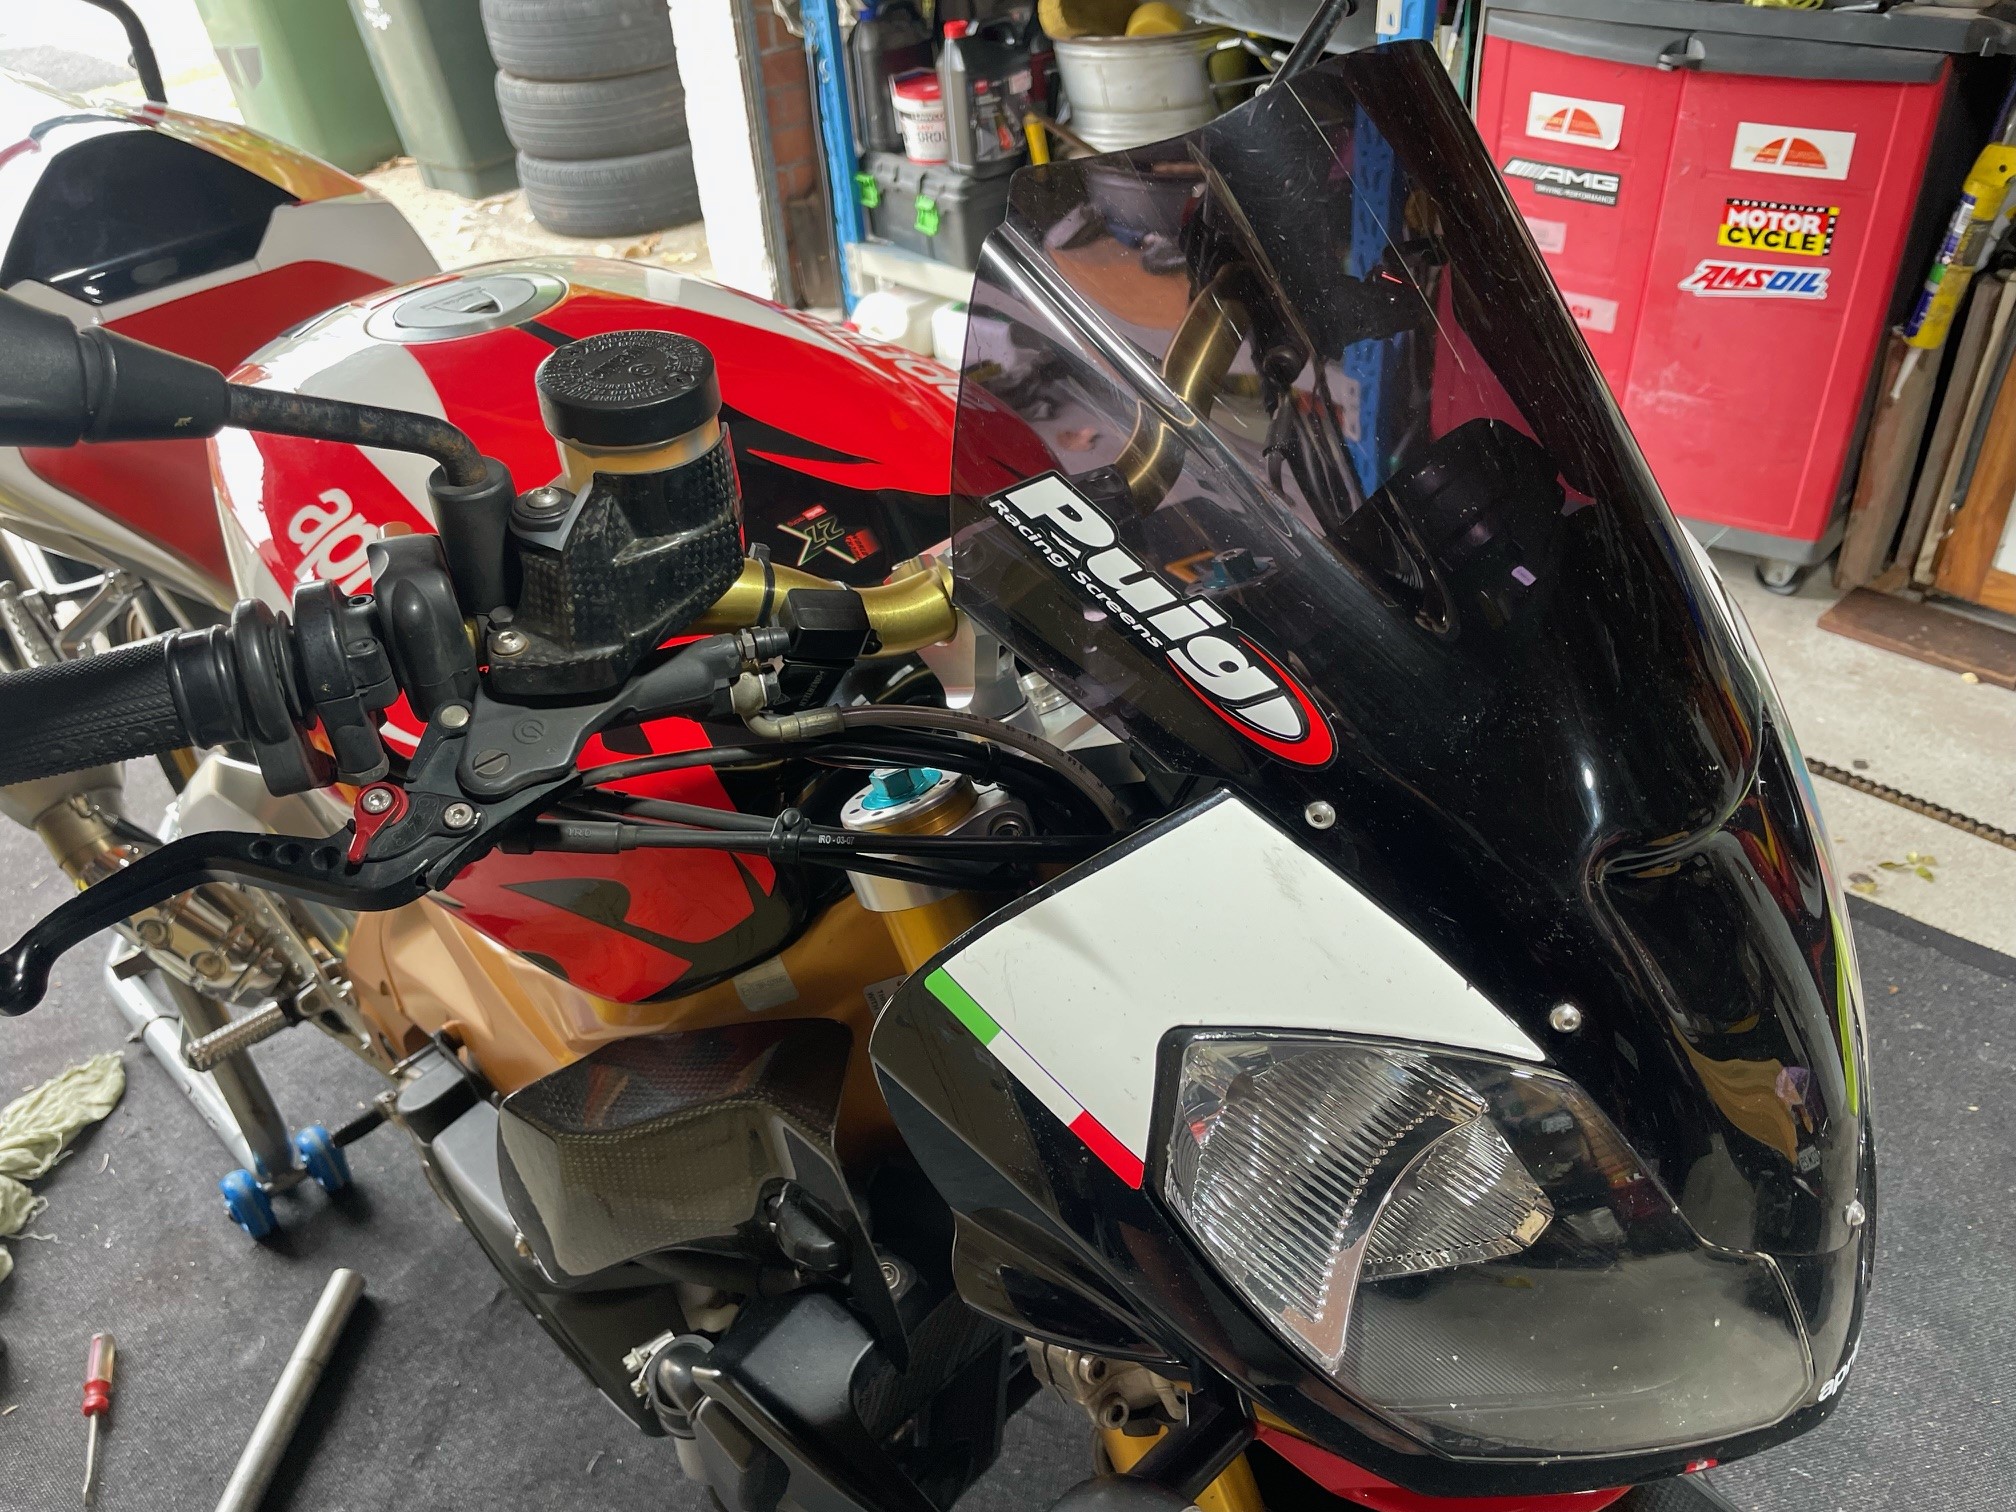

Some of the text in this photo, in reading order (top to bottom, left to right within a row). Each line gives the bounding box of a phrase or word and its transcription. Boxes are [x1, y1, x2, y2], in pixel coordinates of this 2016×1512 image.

[1540, 166, 1619, 192] AMG
[1727, 207, 1821, 234] MOTOR
[1727, 227, 1817, 251] CYCLE
[1692, 265, 1821, 292] AMSOIL
[989, 499, 1164, 649] Racing Screens
[1004, 476, 1285, 705] Puig
